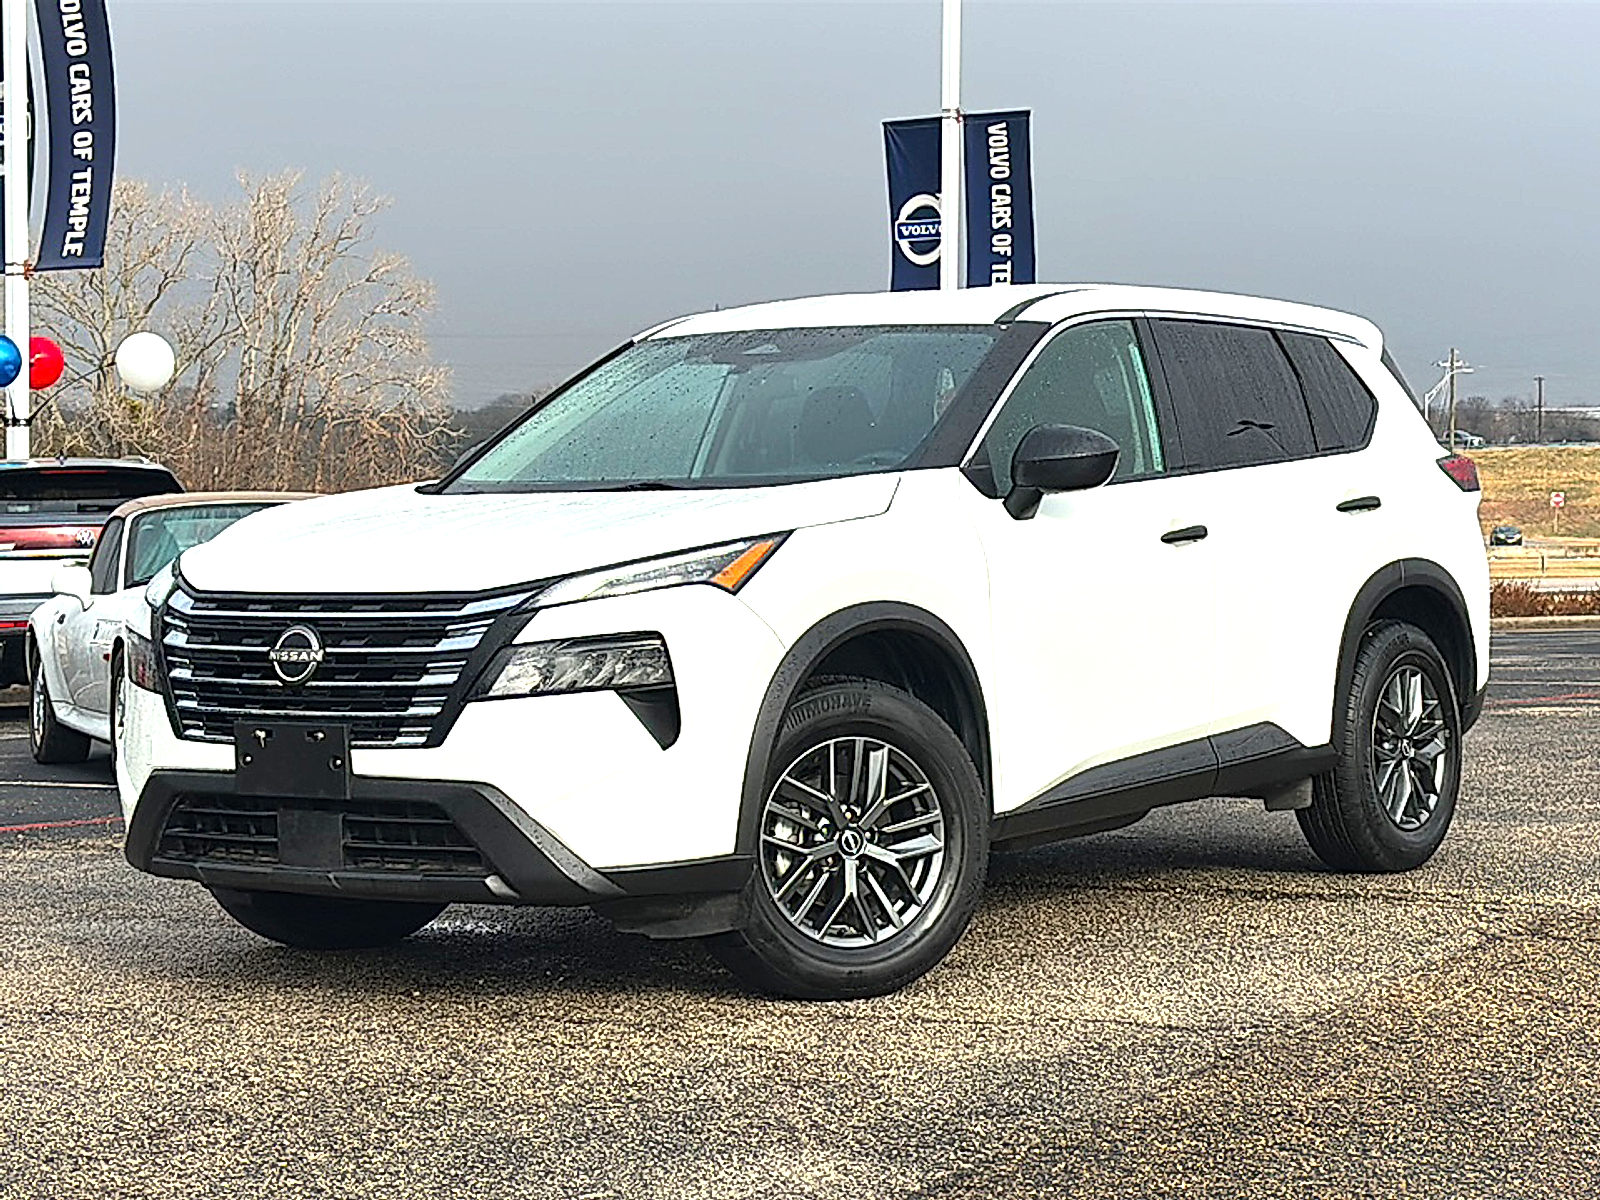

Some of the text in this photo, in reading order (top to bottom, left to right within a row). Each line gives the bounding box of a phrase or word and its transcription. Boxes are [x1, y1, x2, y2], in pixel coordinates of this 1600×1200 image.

[60, 0, 92, 257] OLVO CARS OF TEMPLE
[899, 223, 942, 236] VOLV
[988, 122, 1011, 284] VOLVO CARS OF TE
[269, 649, 324, 662] NISSAN
